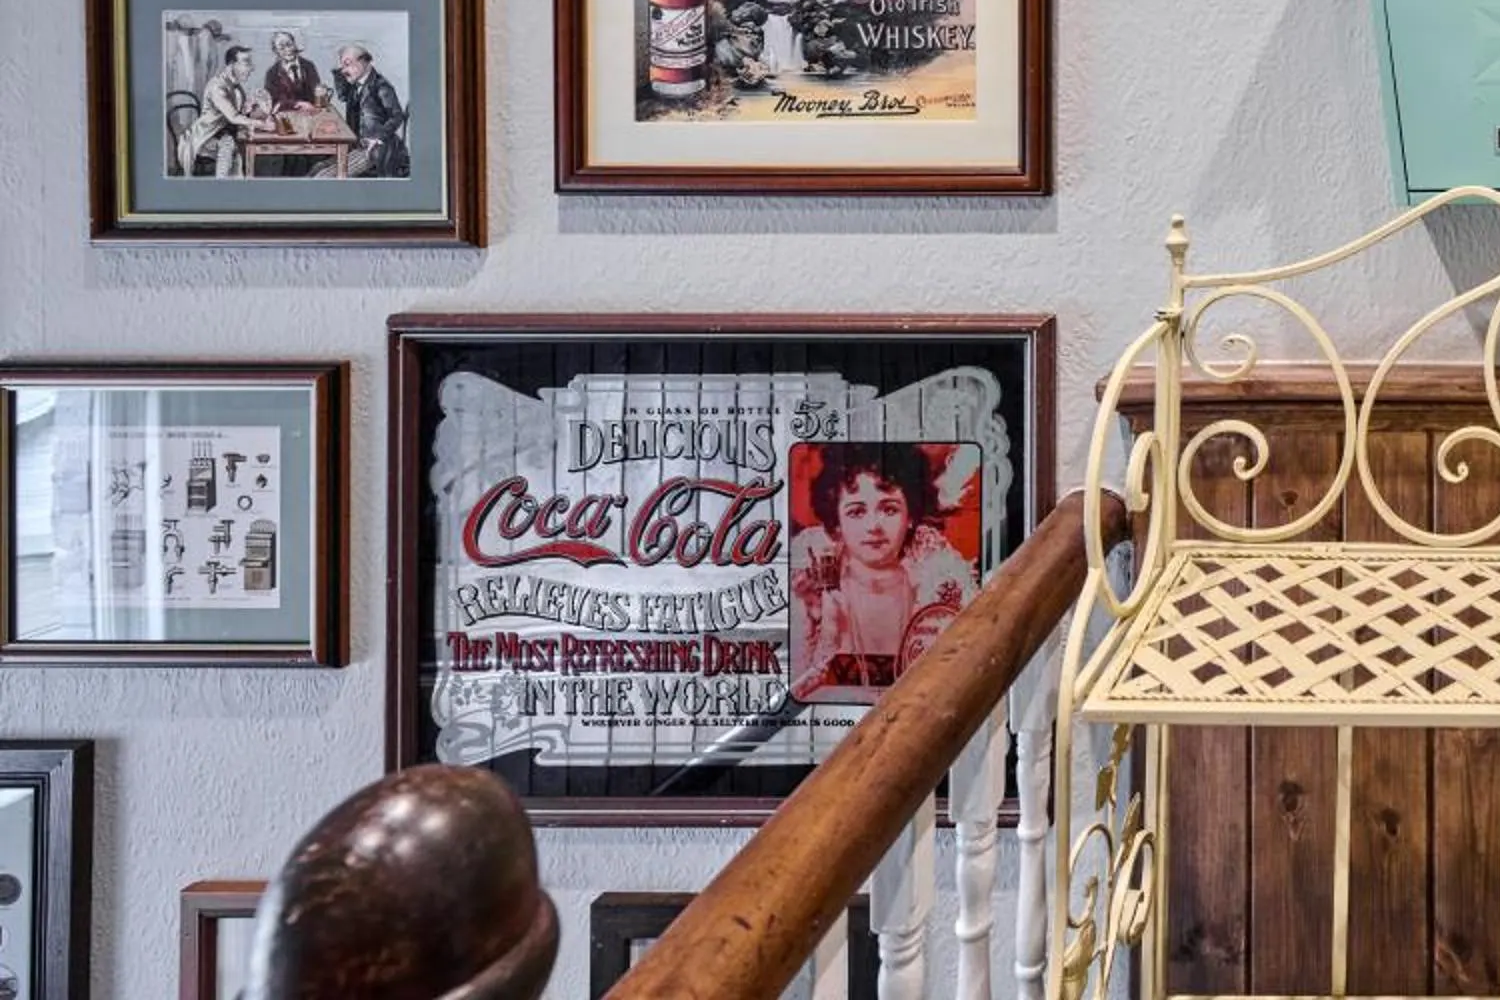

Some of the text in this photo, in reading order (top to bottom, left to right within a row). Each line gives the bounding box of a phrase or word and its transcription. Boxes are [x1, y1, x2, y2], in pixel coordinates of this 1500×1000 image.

[568, 418, 777, 472] DELICIOUS
[455, 568, 789, 634] RELIEVES FATIGUE
[447, 631, 783, 677] THE MOST REFRESHING DRINK
[519, 677, 556, 716] IN
[559, 677, 634, 716] THE
[823, 719, 855, 727] GOOD
